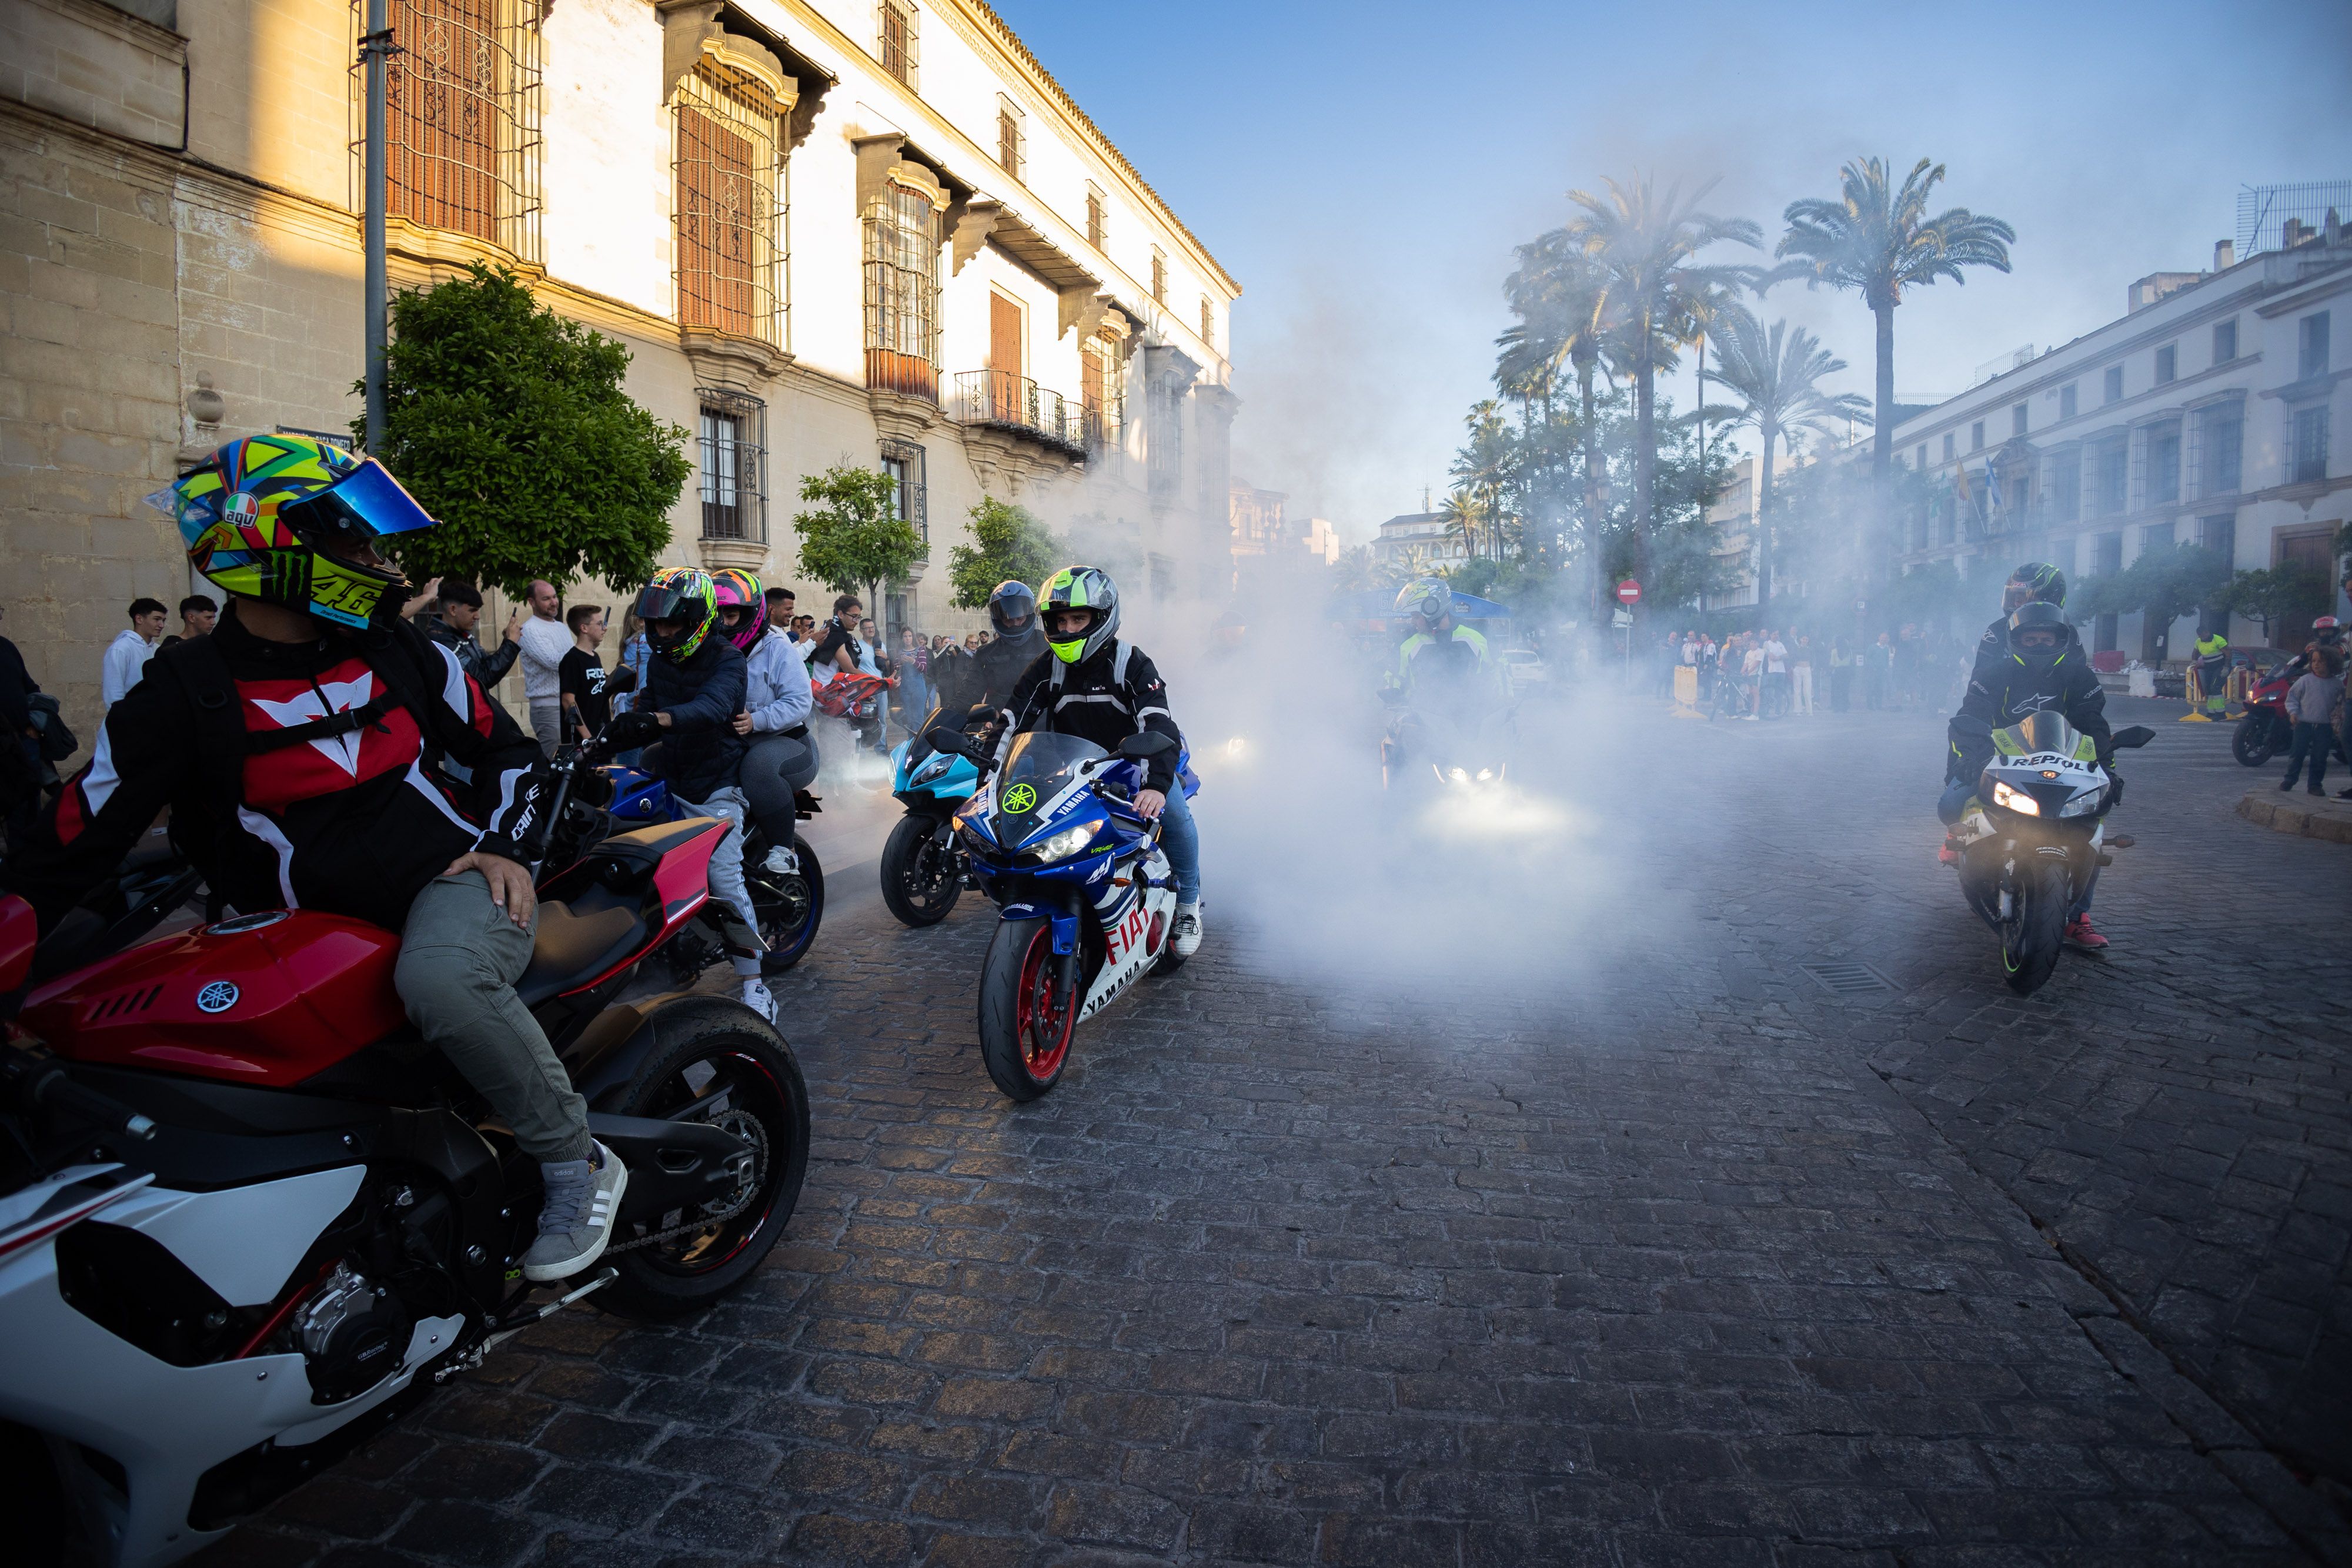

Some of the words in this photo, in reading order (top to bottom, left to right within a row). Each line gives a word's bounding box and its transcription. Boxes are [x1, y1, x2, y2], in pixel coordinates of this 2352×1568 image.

[226, 510, 254, 526] agv
[311, 574, 385, 617] 46
[1378, 591, 1398, 610] GA
[333, 613, 357, 624] Performance
[2012, 755, 2084, 771] REPSOL
[510, 783, 540, 842] DAINE
[1057, 790, 1090, 815] YAMAHA
[1087, 960, 1140, 1014] YAMAHA
